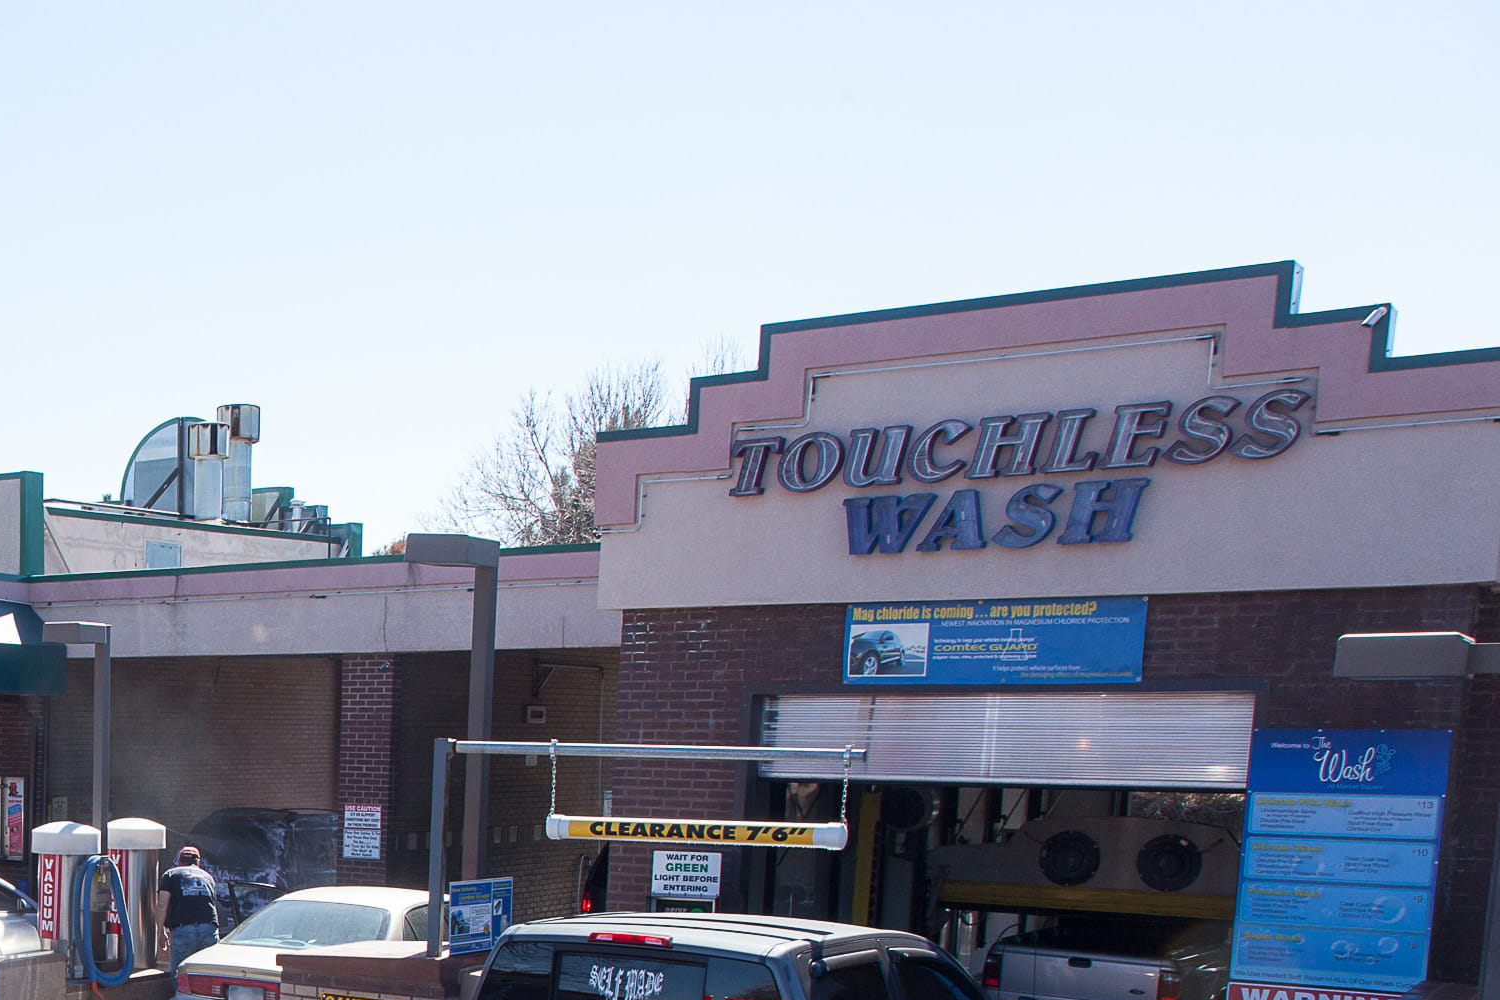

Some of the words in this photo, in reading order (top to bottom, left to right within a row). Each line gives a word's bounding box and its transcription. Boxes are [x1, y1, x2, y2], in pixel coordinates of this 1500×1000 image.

[729, 388, 1311, 496] TOUCHLESS
[843, 477, 1150, 555] WASH
[853, 606, 874, 621] Mag
[876, 605, 919, 620] chloride
[921, 605, 931, 619] is
[989, 605, 1008, 617] are
[1011, 605, 1031, 617] you
[1033, 601, 1097, 617] protected?
[1014, 618, 1053, 626] MAGNESIUM
[1054, 617, 1086, 625] CHLORIDE
[1311, 736, 1332, 749] The
[1313, 747, 1374, 782] Wash
[590, 821, 736, 840] CLEARANCE
[689, 854, 709, 862] FOR
[665, 862, 708, 873] GREEN
[654, 874, 681, 882] LIGHT
[682, 875, 718, 883] BEFORE
[41, 858, 54, 931] VACUUM
[663, 884, 708, 893] ENTERING
